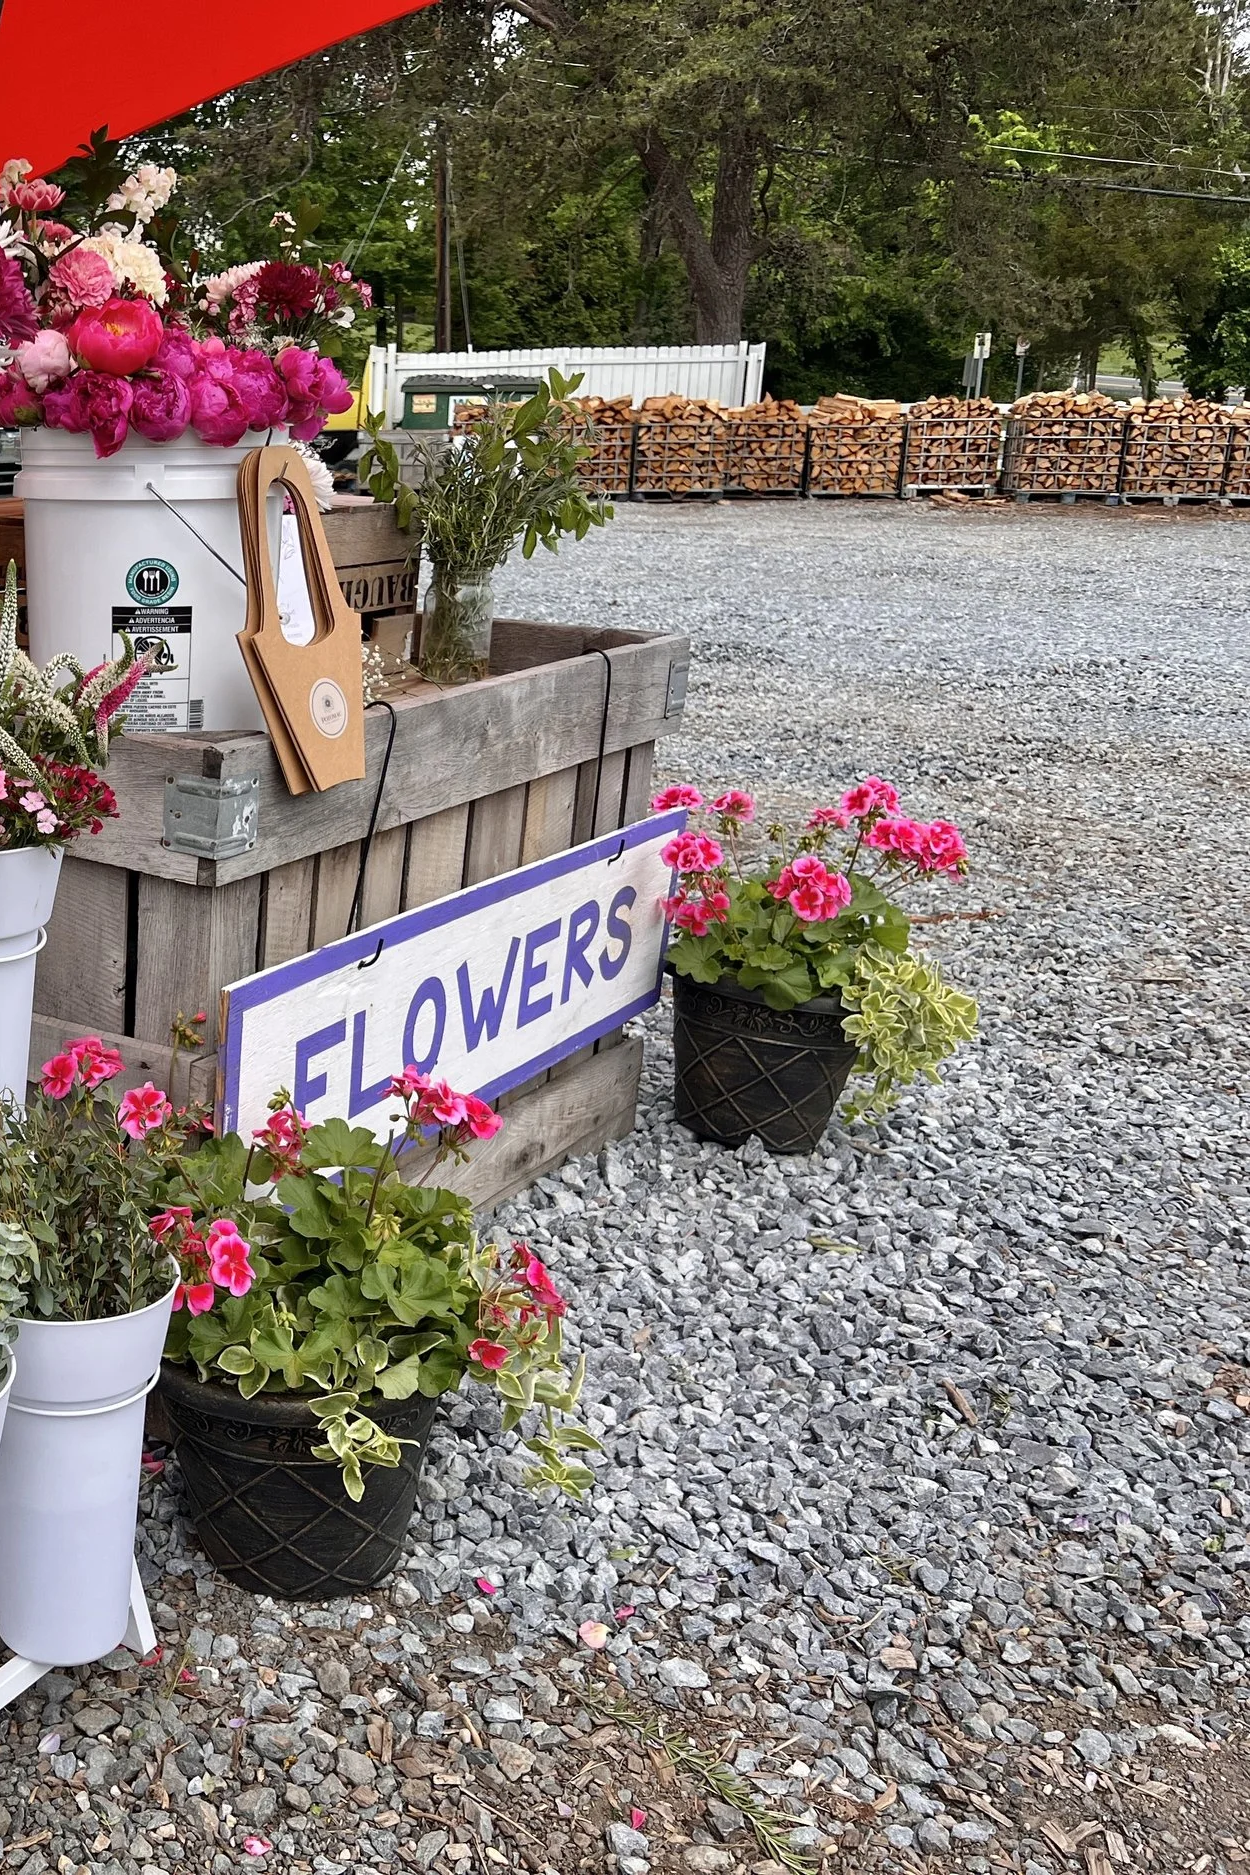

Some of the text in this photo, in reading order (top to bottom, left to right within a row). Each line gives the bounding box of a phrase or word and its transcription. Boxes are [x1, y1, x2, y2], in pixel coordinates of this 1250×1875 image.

[128, 560, 177, 583] MANUFACTURED USING
[129, 587, 141, 601] FOOD
[161, 586, 175, 601] RESIN
[294, 885, 637, 1119] FLOWERS
